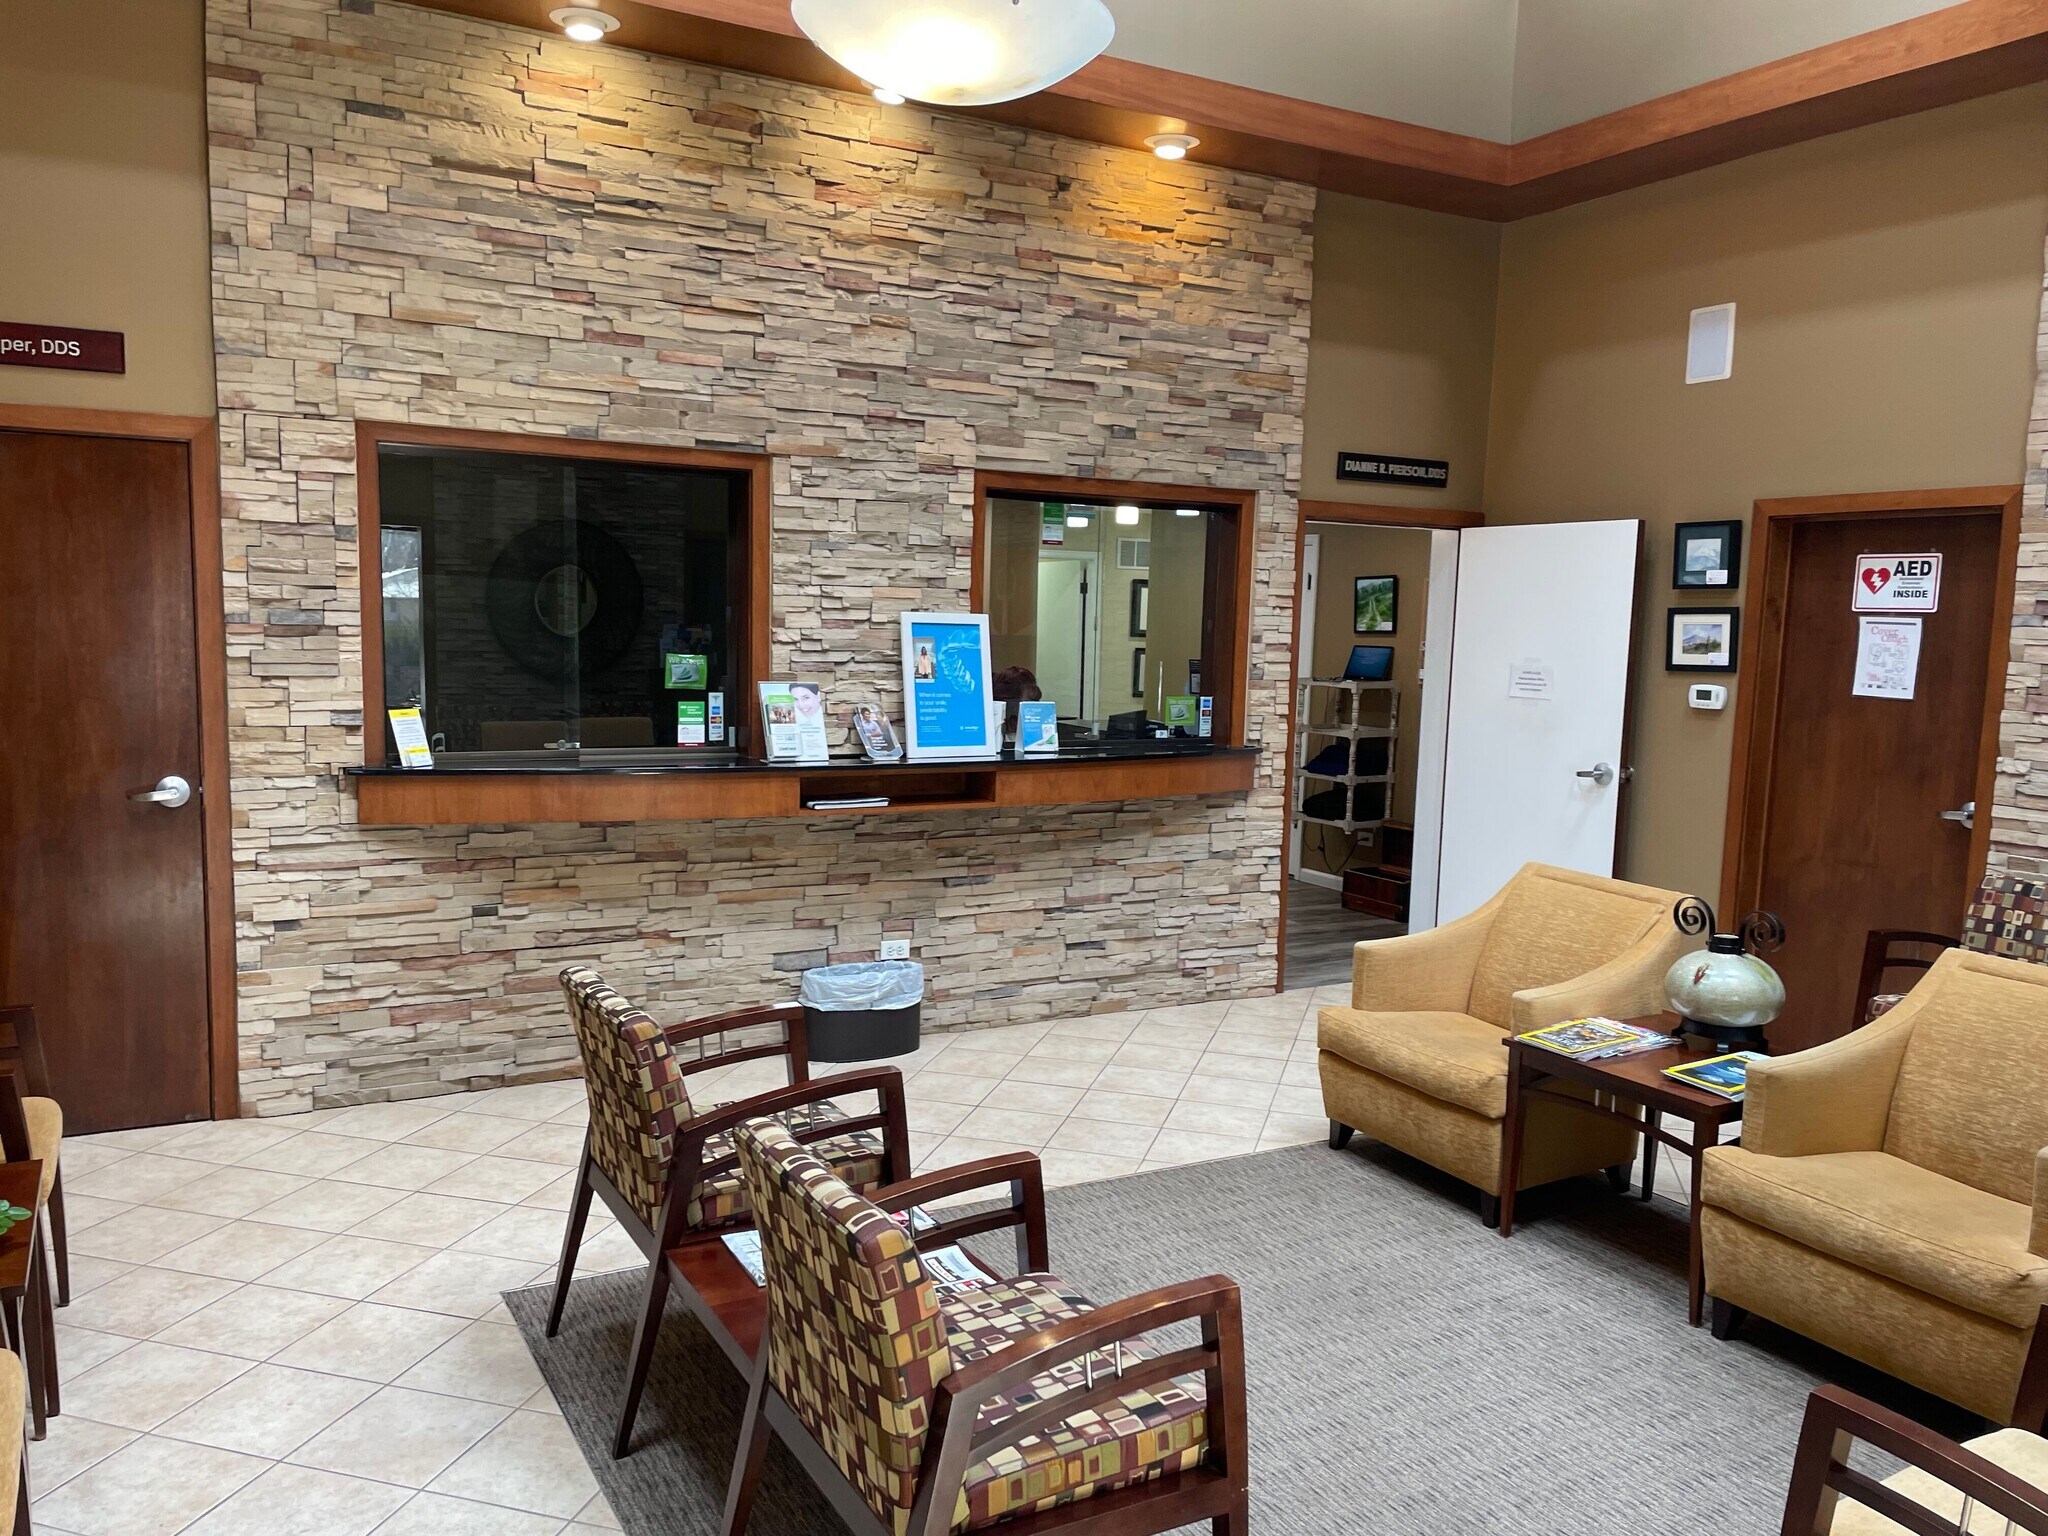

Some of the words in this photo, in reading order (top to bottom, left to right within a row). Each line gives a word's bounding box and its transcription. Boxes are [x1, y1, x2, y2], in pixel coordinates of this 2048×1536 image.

[0, 339, 36, 355] per,
[41, 339, 80, 356] DDS
[1345, 460, 1378, 473] DIANNE
[1388, 464, 1427, 478] PIERSON,
[1893, 560, 1932, 577] AED
[1893, 590, 1928, 598] INSIDE
[668, 656, 680, 664] We
